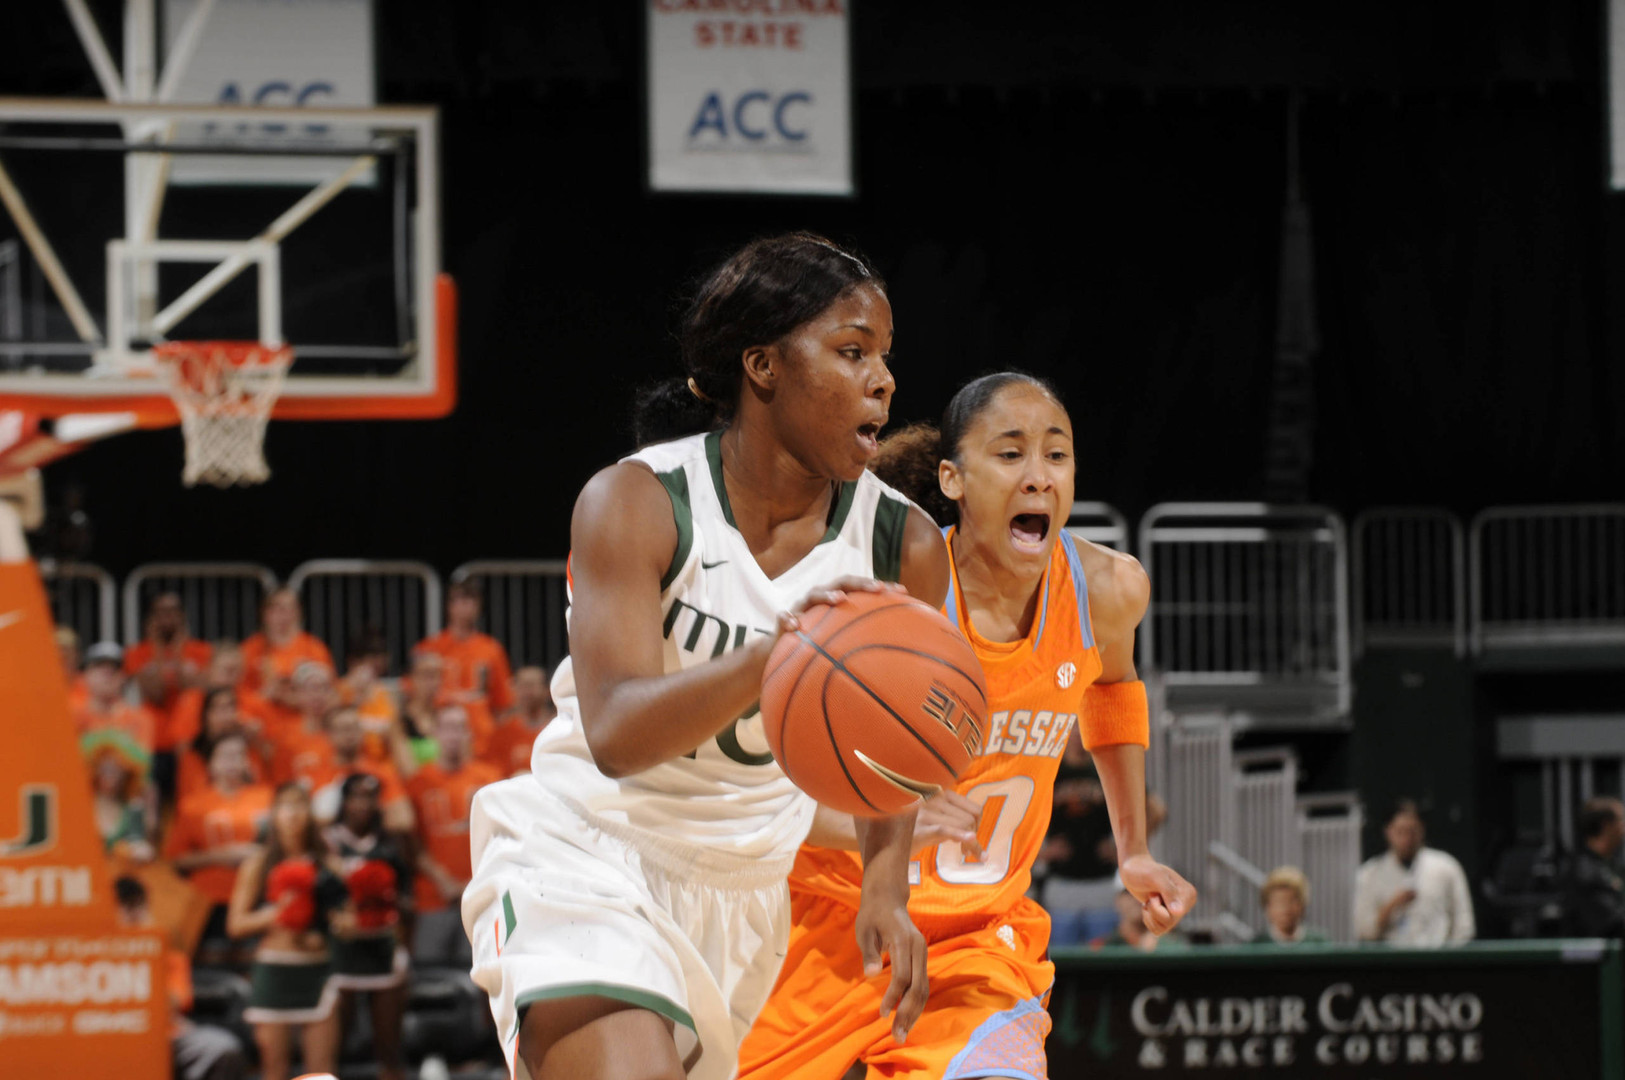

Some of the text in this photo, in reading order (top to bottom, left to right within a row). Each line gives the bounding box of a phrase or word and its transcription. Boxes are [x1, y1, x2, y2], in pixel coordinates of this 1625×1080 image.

[694, 20, 804, 49] STATE
[687, 89, 815, 142] ACC
[1056, 662, 1077, 689] SEC
[975, 709, 1078, 759] ESSEE
[1131, 982, 1483, 1037] CALDER CASINO
[1138, 1033, 1483, 1069] & RACE COURSE
